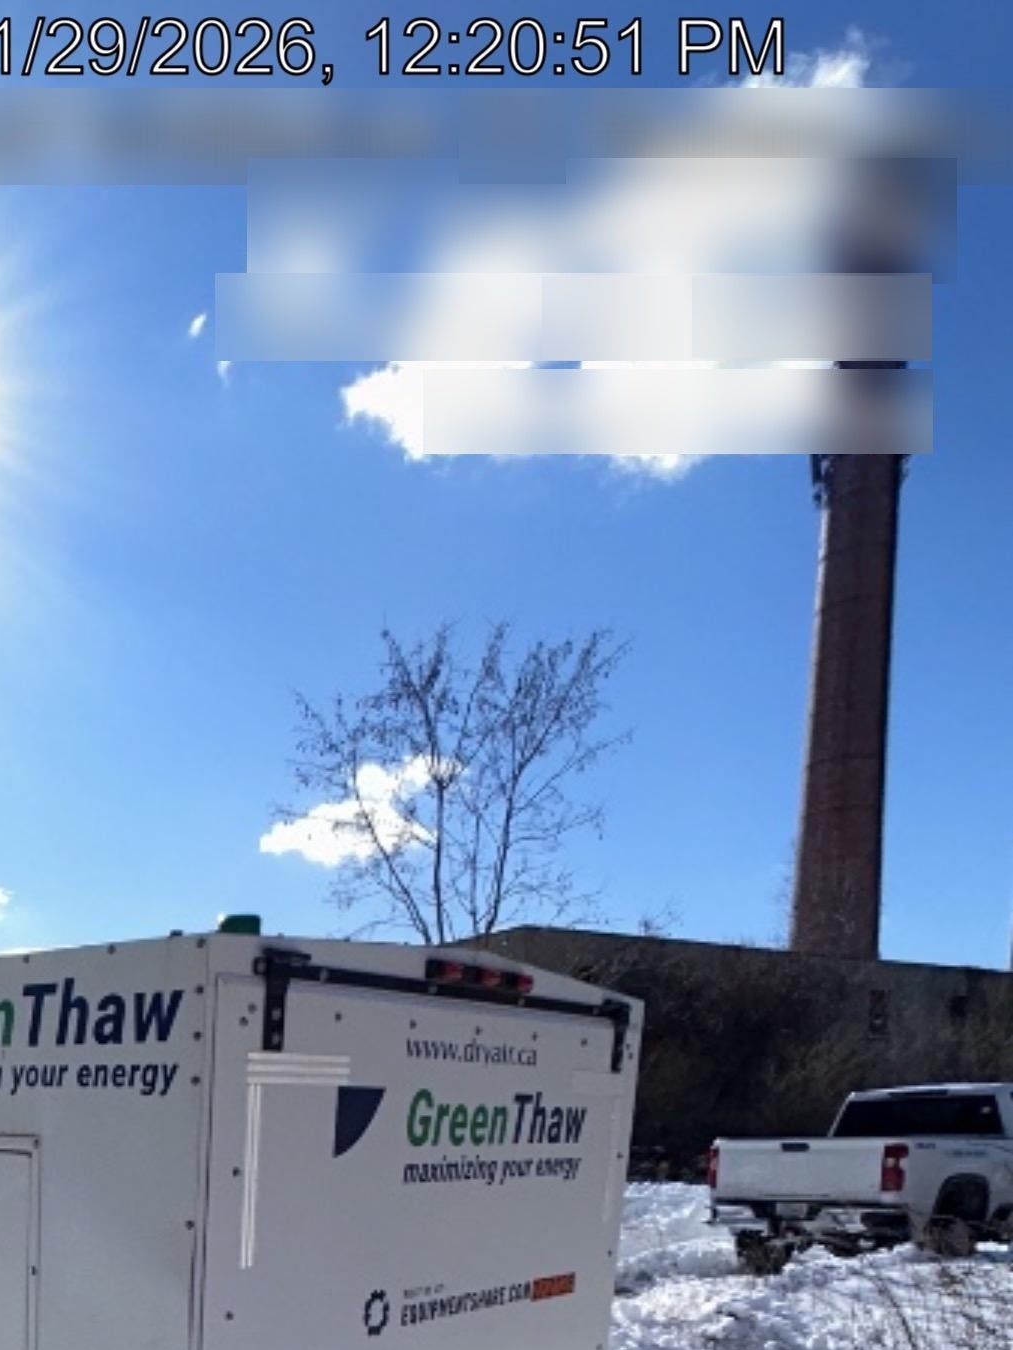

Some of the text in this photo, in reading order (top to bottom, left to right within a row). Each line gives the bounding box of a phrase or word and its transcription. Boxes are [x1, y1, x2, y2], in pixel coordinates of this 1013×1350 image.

[406, 1037, 537, 1067] www.dryair.ca
[10, 1061, 69, 1096] your
[77, 1058, 178, 1096] energy
[403, 1154, 582, 1185] maximizing your energy
